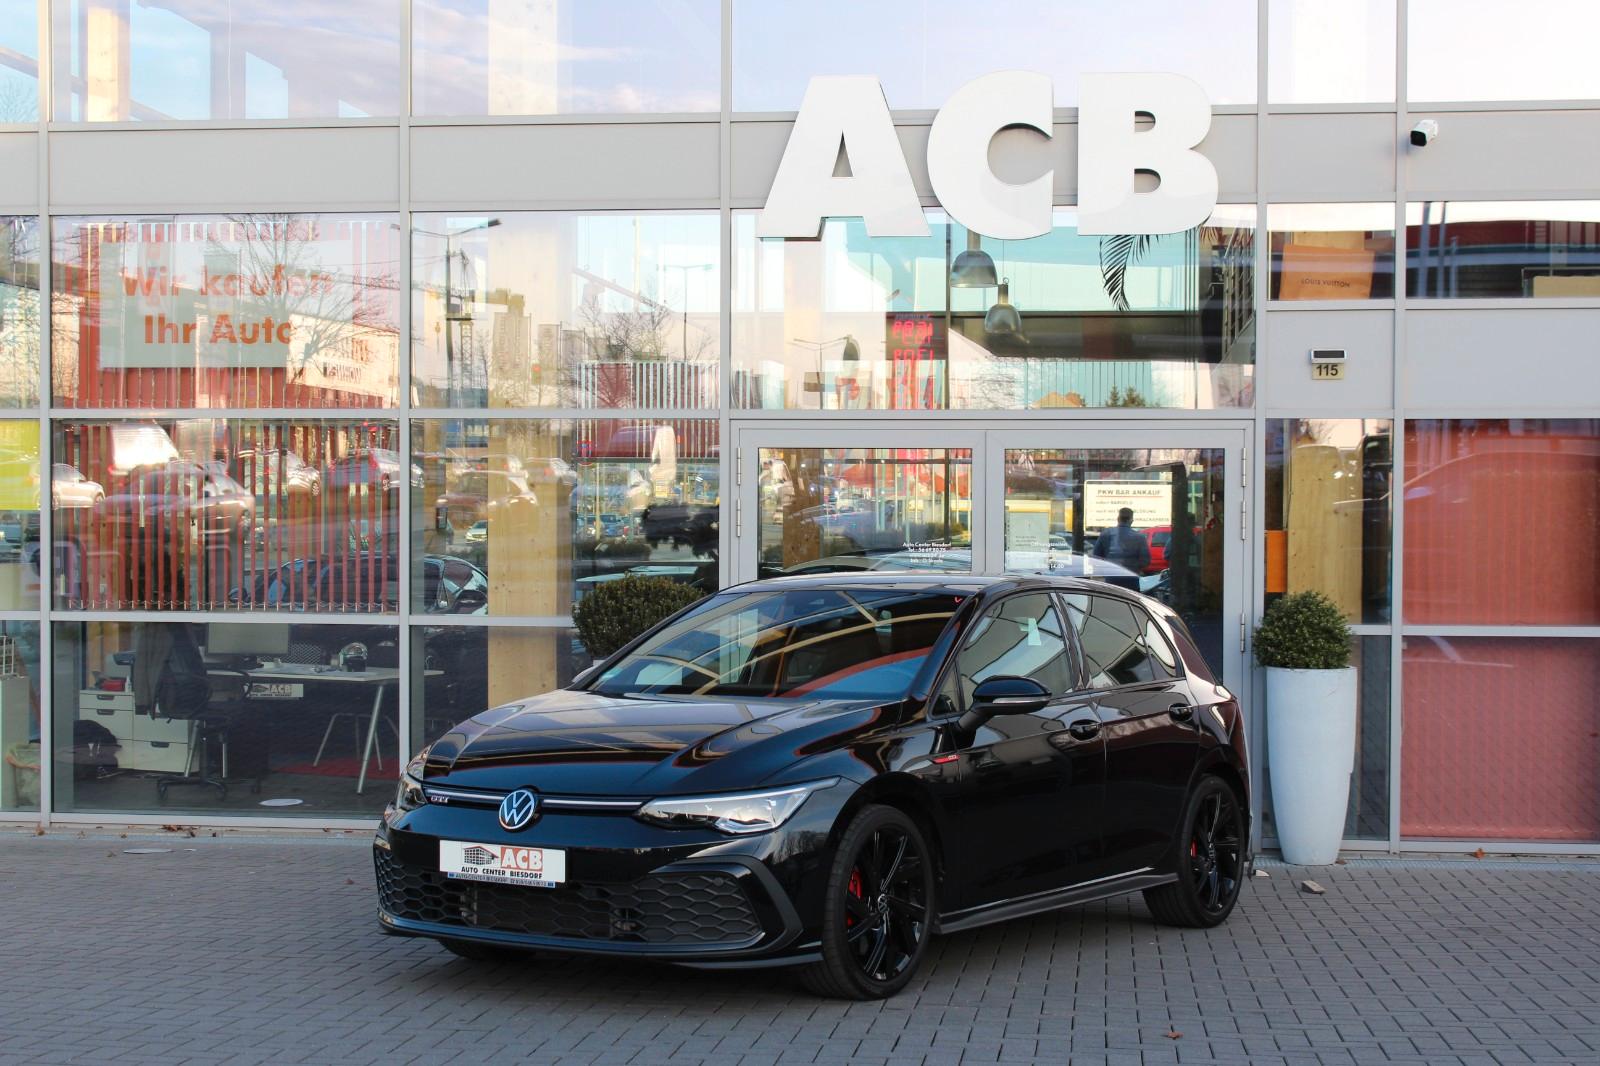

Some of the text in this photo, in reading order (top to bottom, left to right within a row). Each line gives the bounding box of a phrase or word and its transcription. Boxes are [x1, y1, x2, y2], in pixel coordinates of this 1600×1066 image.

[755, 69, 1219, 240] ACB
[121, 263, 334, 297] Wir kaufen
[144, 313, 295, 345] Ihr Auto
[1316, 364, 1338, 377] 115
[501, 847, 543, 870] ACB
[461, 866, 479, 874] AUTO
[482, 868, 506, 877] CENTER
[510, 870, 543, 880] BIESDORF
